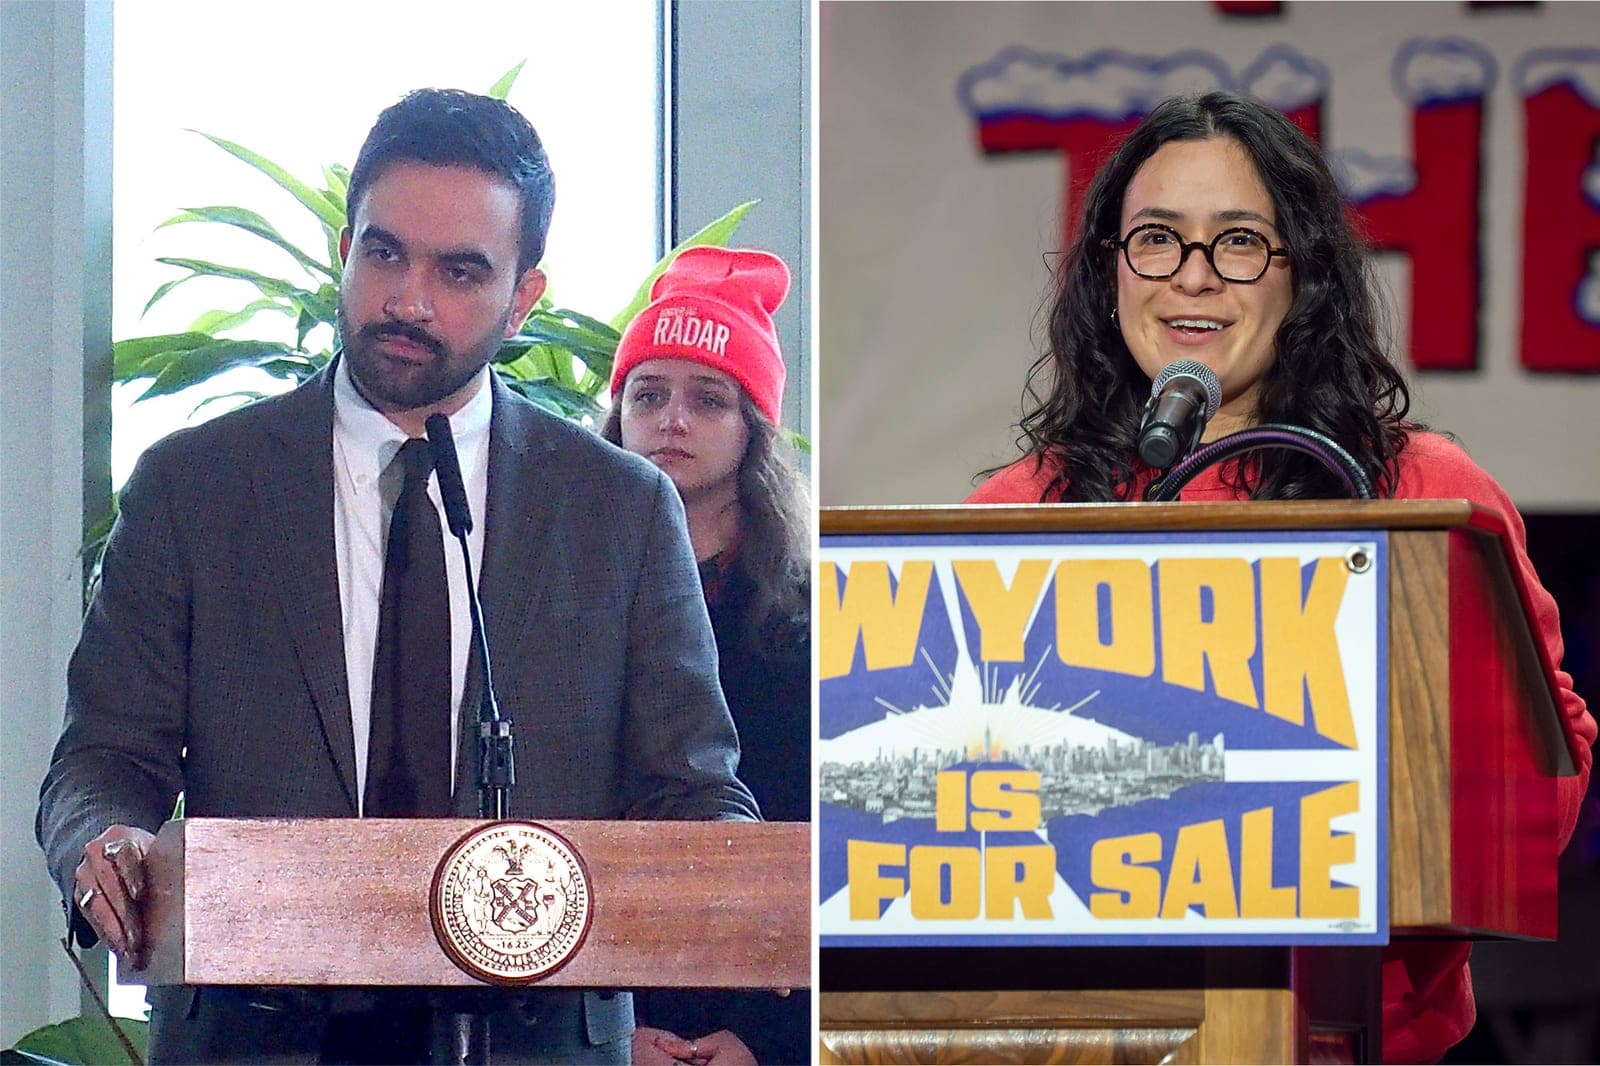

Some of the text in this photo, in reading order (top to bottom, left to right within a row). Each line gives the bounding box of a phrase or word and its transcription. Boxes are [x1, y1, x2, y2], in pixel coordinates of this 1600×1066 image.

[653, 316, 730, 356] RADAR
[952, 557, 1359, 750] YORK
[847, 780, 1360, 921] FOR SALE
[936, 770, 1041, 831] IS
